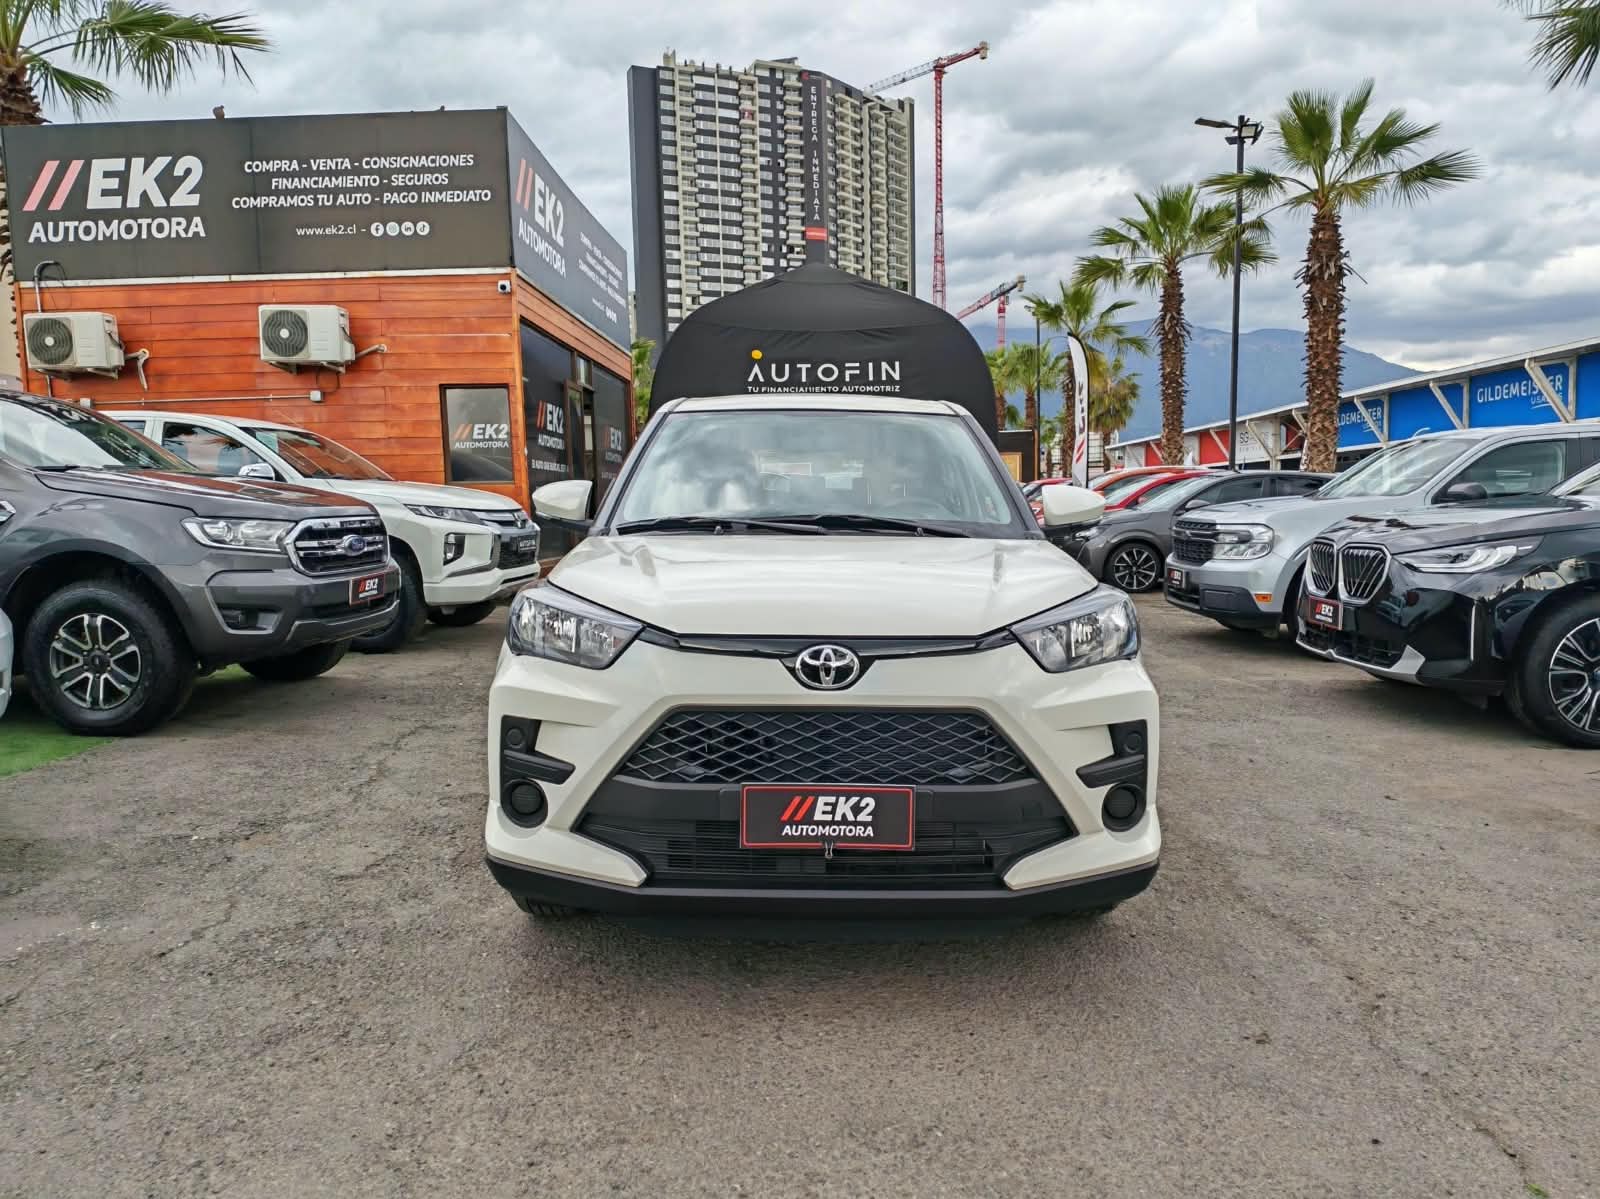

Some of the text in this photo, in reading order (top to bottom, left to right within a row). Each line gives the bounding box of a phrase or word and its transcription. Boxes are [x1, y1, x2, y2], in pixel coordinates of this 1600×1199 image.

[244, 159, 299, 173] COMPRA
[310, 157, 351, 171] VENTA
[362, 154, 474, 169] CONSIGNACIONES
[271, 174, 380, 190] FINANCIAMIENTO
[391, 173, 449, 186] SEGUROS
[812, 150, 820, 221] INMEDIATA
[231, 195, 314, 209] COMPRAMOS
[317, 194, 333, 207] TU
[336, 192, 372, 206] AUTO
[383, 191, 418, 204] PAGO
[421, 189, 492, 203] INMEDIATO
[27, 216, 206, 243] AUTOMOTORA
[296, 224, 357, 237] www.ek2.cl
[518, 217, 566, 279] AUTOMOTORA
[747, 359, 900, 383] AUTOFIN
[841, 385, 900, 393] AUTOMOTRIZ
[1477, 374, 1563, 404] GILDEMEISER
[454, 440, 509, 449] AUTOMOTORA
[781, 824, 874, 837] AUTOMOTORA
